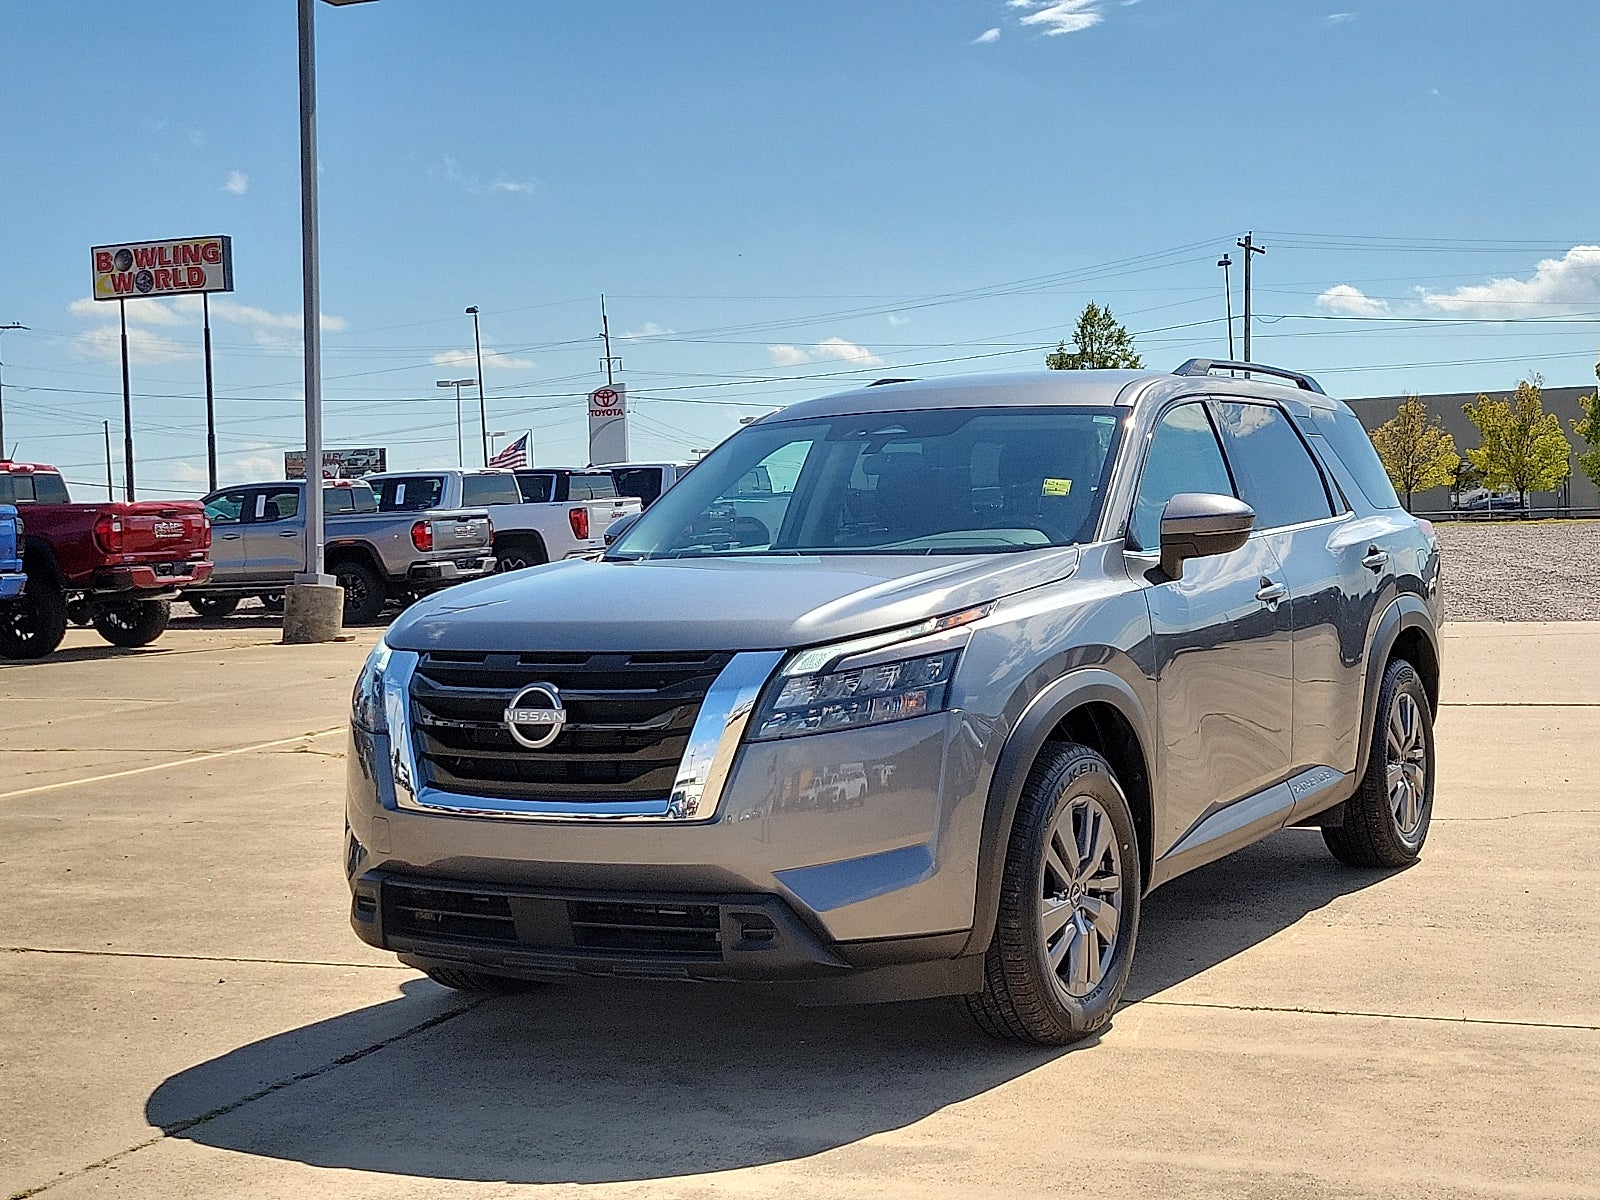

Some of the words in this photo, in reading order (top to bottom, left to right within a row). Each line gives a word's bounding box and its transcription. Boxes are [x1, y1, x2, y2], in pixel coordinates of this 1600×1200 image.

[96, 243, 220, 273] BOWLING
[111, 267, 206, 294] WORLD
[590, 409, 624, 417] TOYOTA
[505, 711, 564, 721] NISSAN
